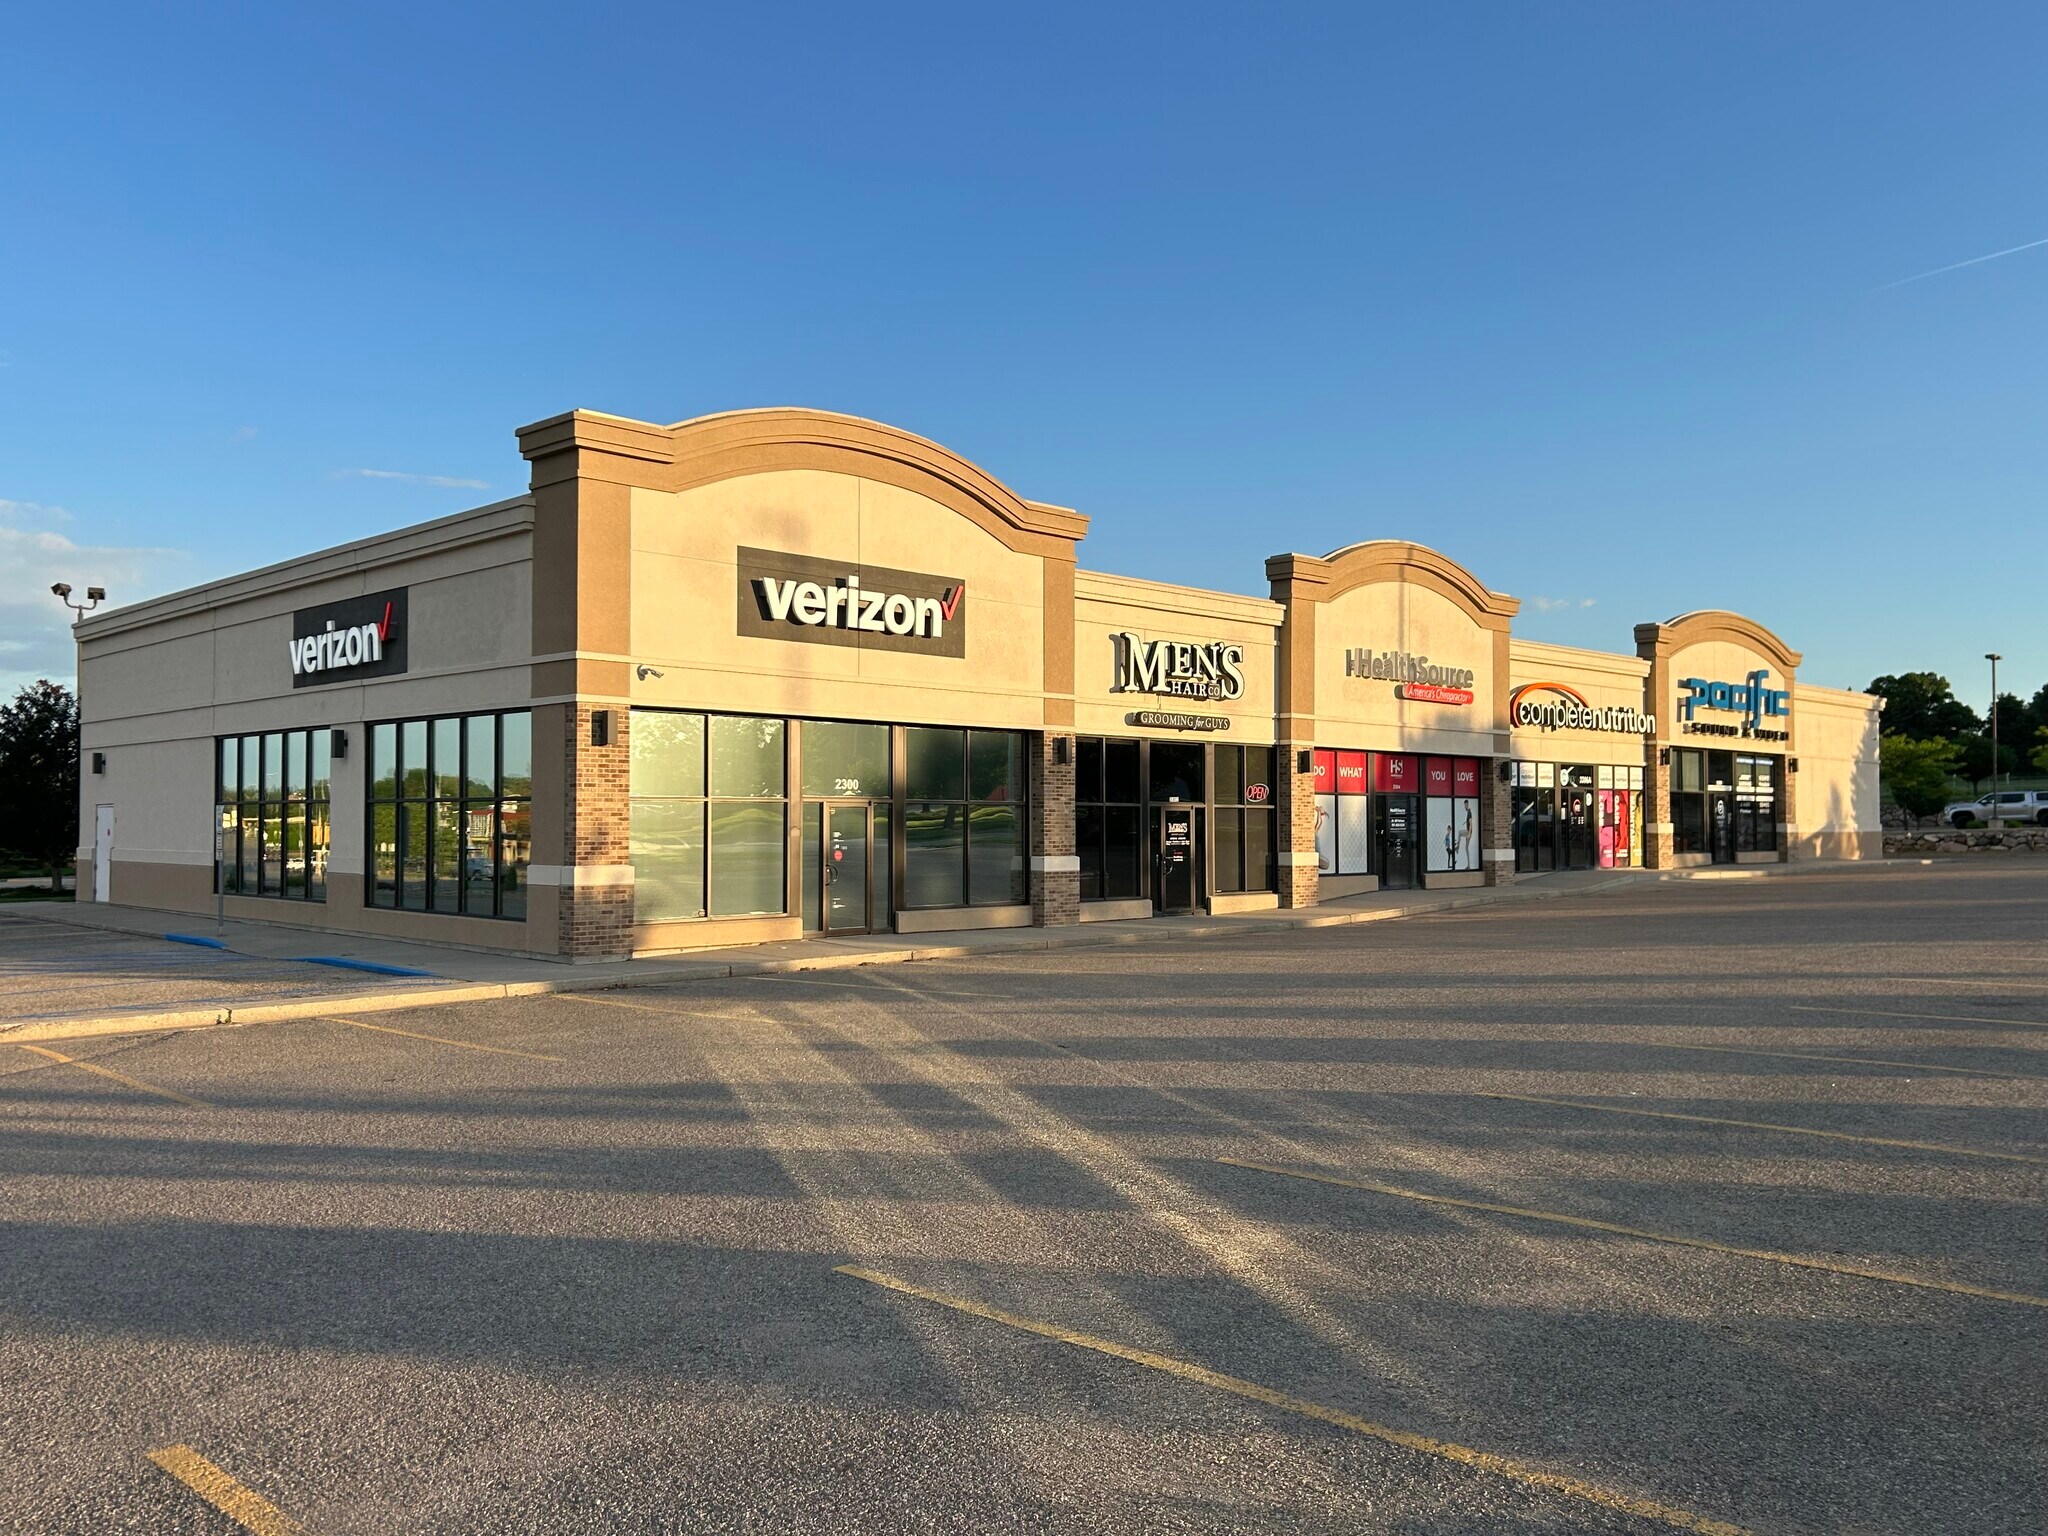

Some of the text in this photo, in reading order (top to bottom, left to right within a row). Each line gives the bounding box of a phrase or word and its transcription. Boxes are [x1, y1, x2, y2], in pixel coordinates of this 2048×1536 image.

[762, 574, 943, 638] verizon
[289, 620, 382, 675] verizon
[1354, 647, 1474, 689] HealthSource
[1171, 680, 1208, 697] HAIR
[1408, 686, 1470, 703] America's Chiropractor
[1685, 669, 1790, 729] pacific
[1140, 712, 1194, 727] GROOMING
[1205, 717, 1229, 730] GUYS
[1313, 765, 1474, 782] DO WHAT YOU LOVE
[834, 778, 859, 790] 2300
[1246, 785, 1267, 800] OPEN
